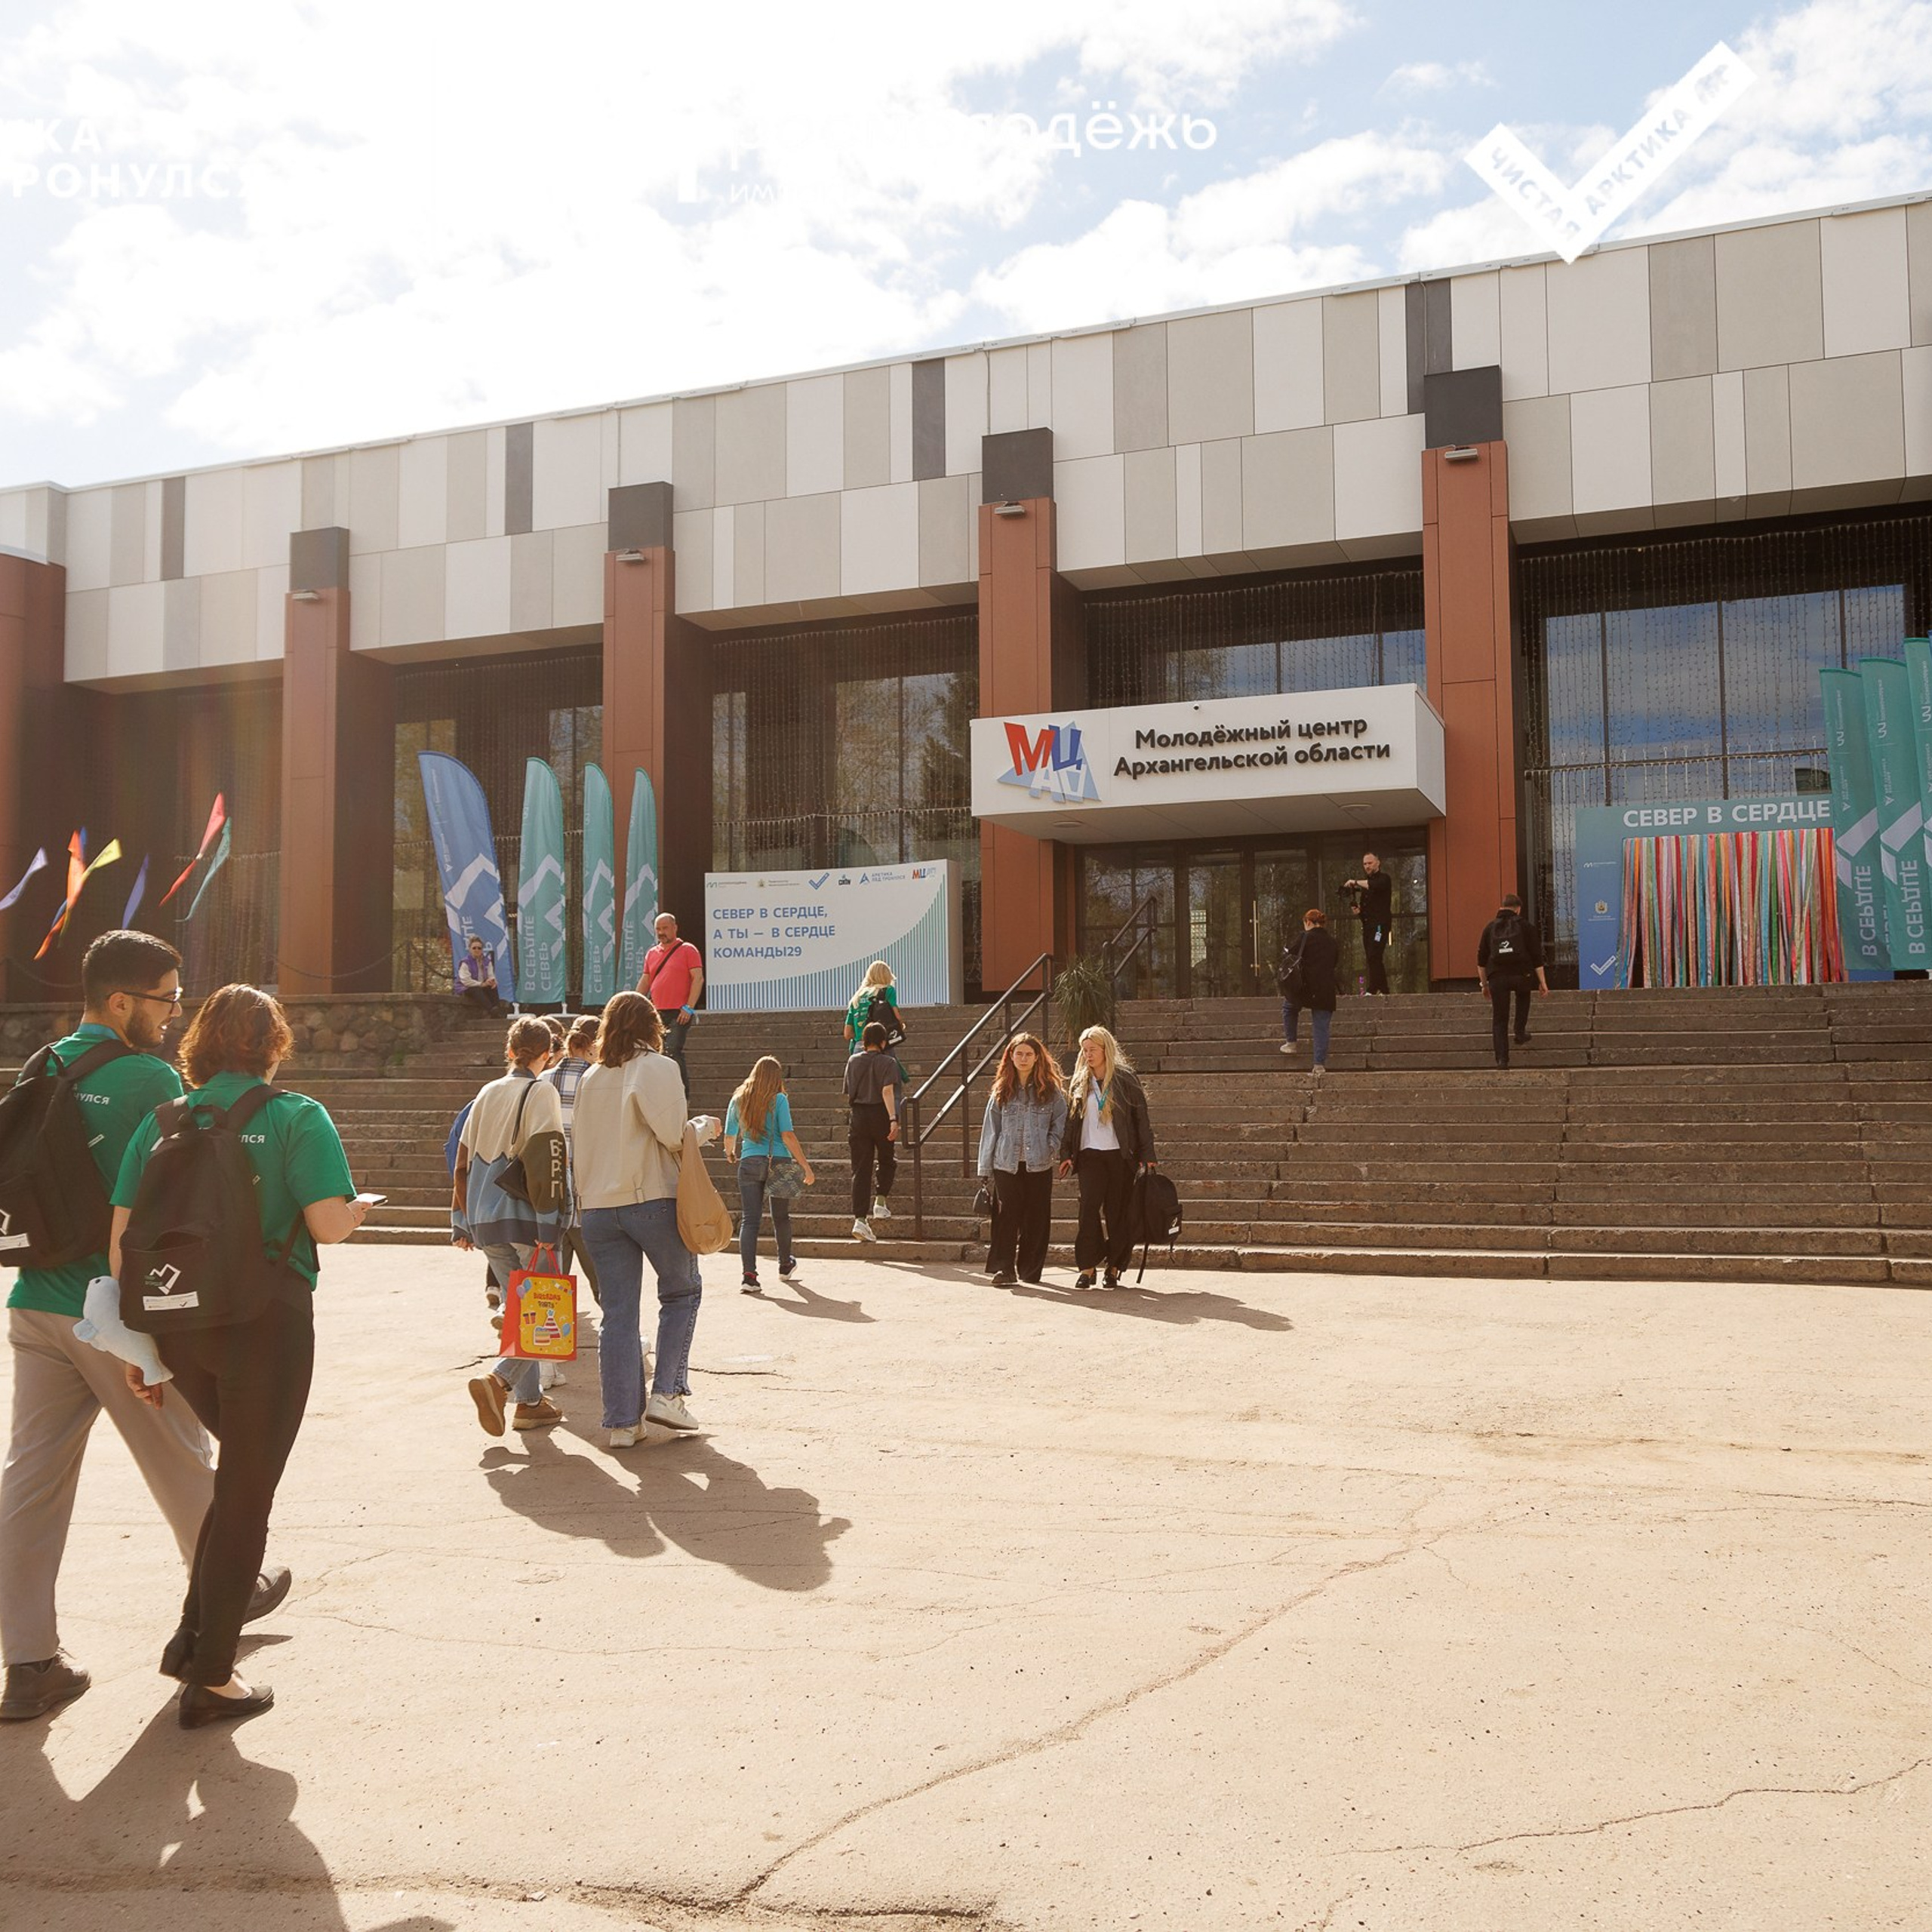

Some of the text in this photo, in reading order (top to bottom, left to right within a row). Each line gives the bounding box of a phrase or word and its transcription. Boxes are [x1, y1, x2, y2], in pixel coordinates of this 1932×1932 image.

[1135, 718, 1368, 749] Молодёжный центр
[1113, 742, 1391, 780] Архангельской области
[1623, 799, 1831, 827] СЕВЕР В СЕРДЦЕ
[712, 906, 828, 920] СЕВЕР В СЕРДЦЕ,
[712, 928, 723, 940] А
[728, 928, 749, 940] ТЫ
[771, 928, 780, 938] В
[784, 925, 836, 938] СЕРДЦЕ
[712, 946, 802, 958] КОМАНДЫ29
[238, 1134, 265, 1144] ЛСЯ
